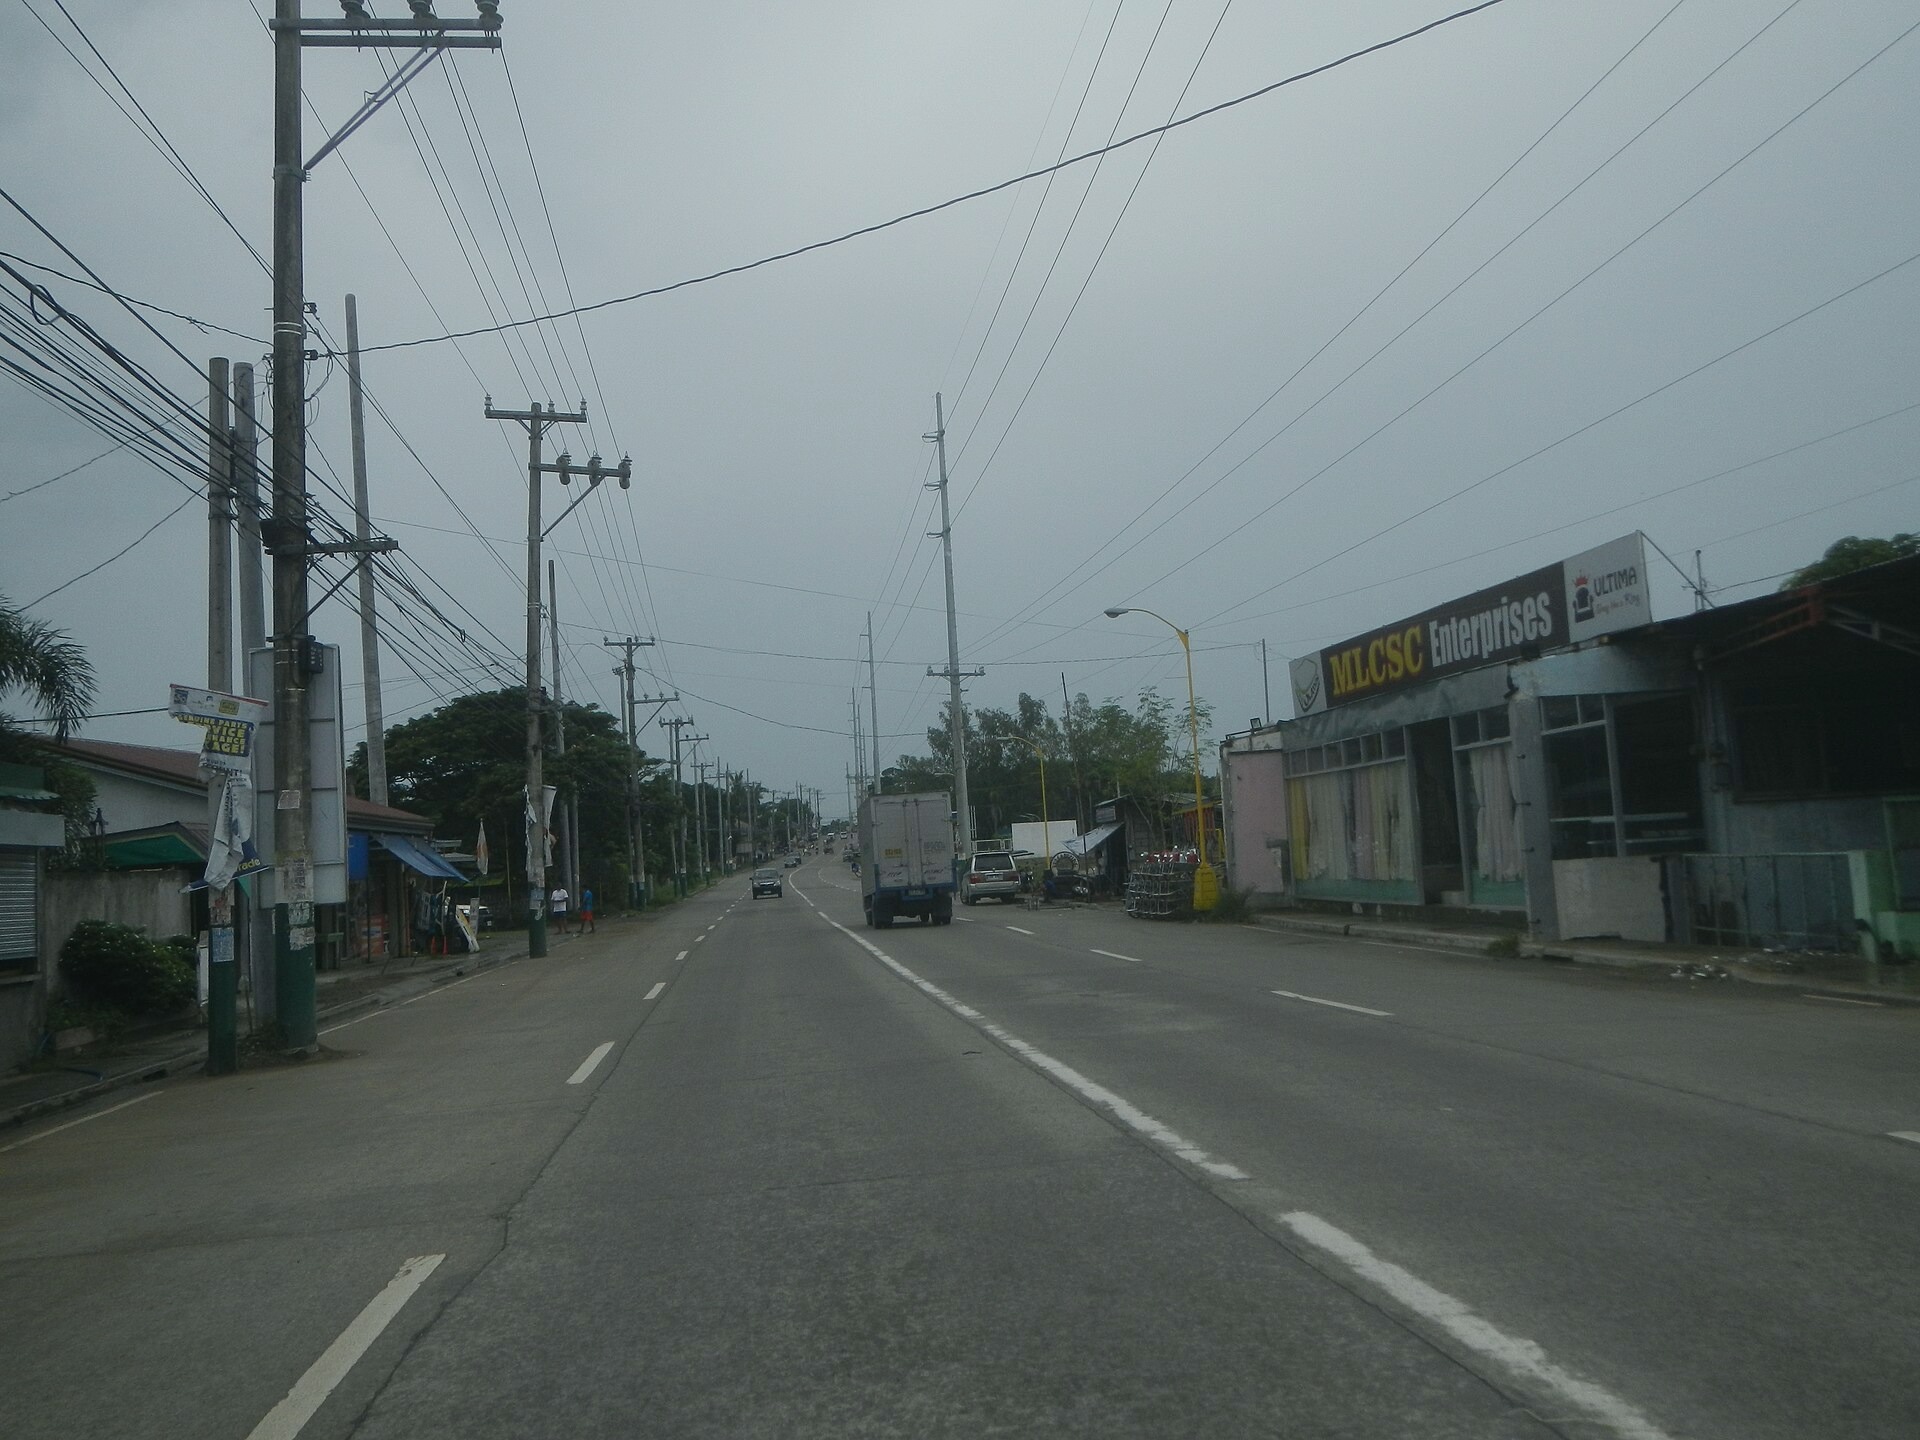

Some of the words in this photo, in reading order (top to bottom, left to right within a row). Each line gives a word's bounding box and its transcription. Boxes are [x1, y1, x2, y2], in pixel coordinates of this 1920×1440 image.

[1593, 566, 1638, 597] ULTIMA
[1329, 625, 1423, 696] MLCSC
[1428, 591, 1553, 668] Enterprises
[218, 719, 248, 729] PARTS
